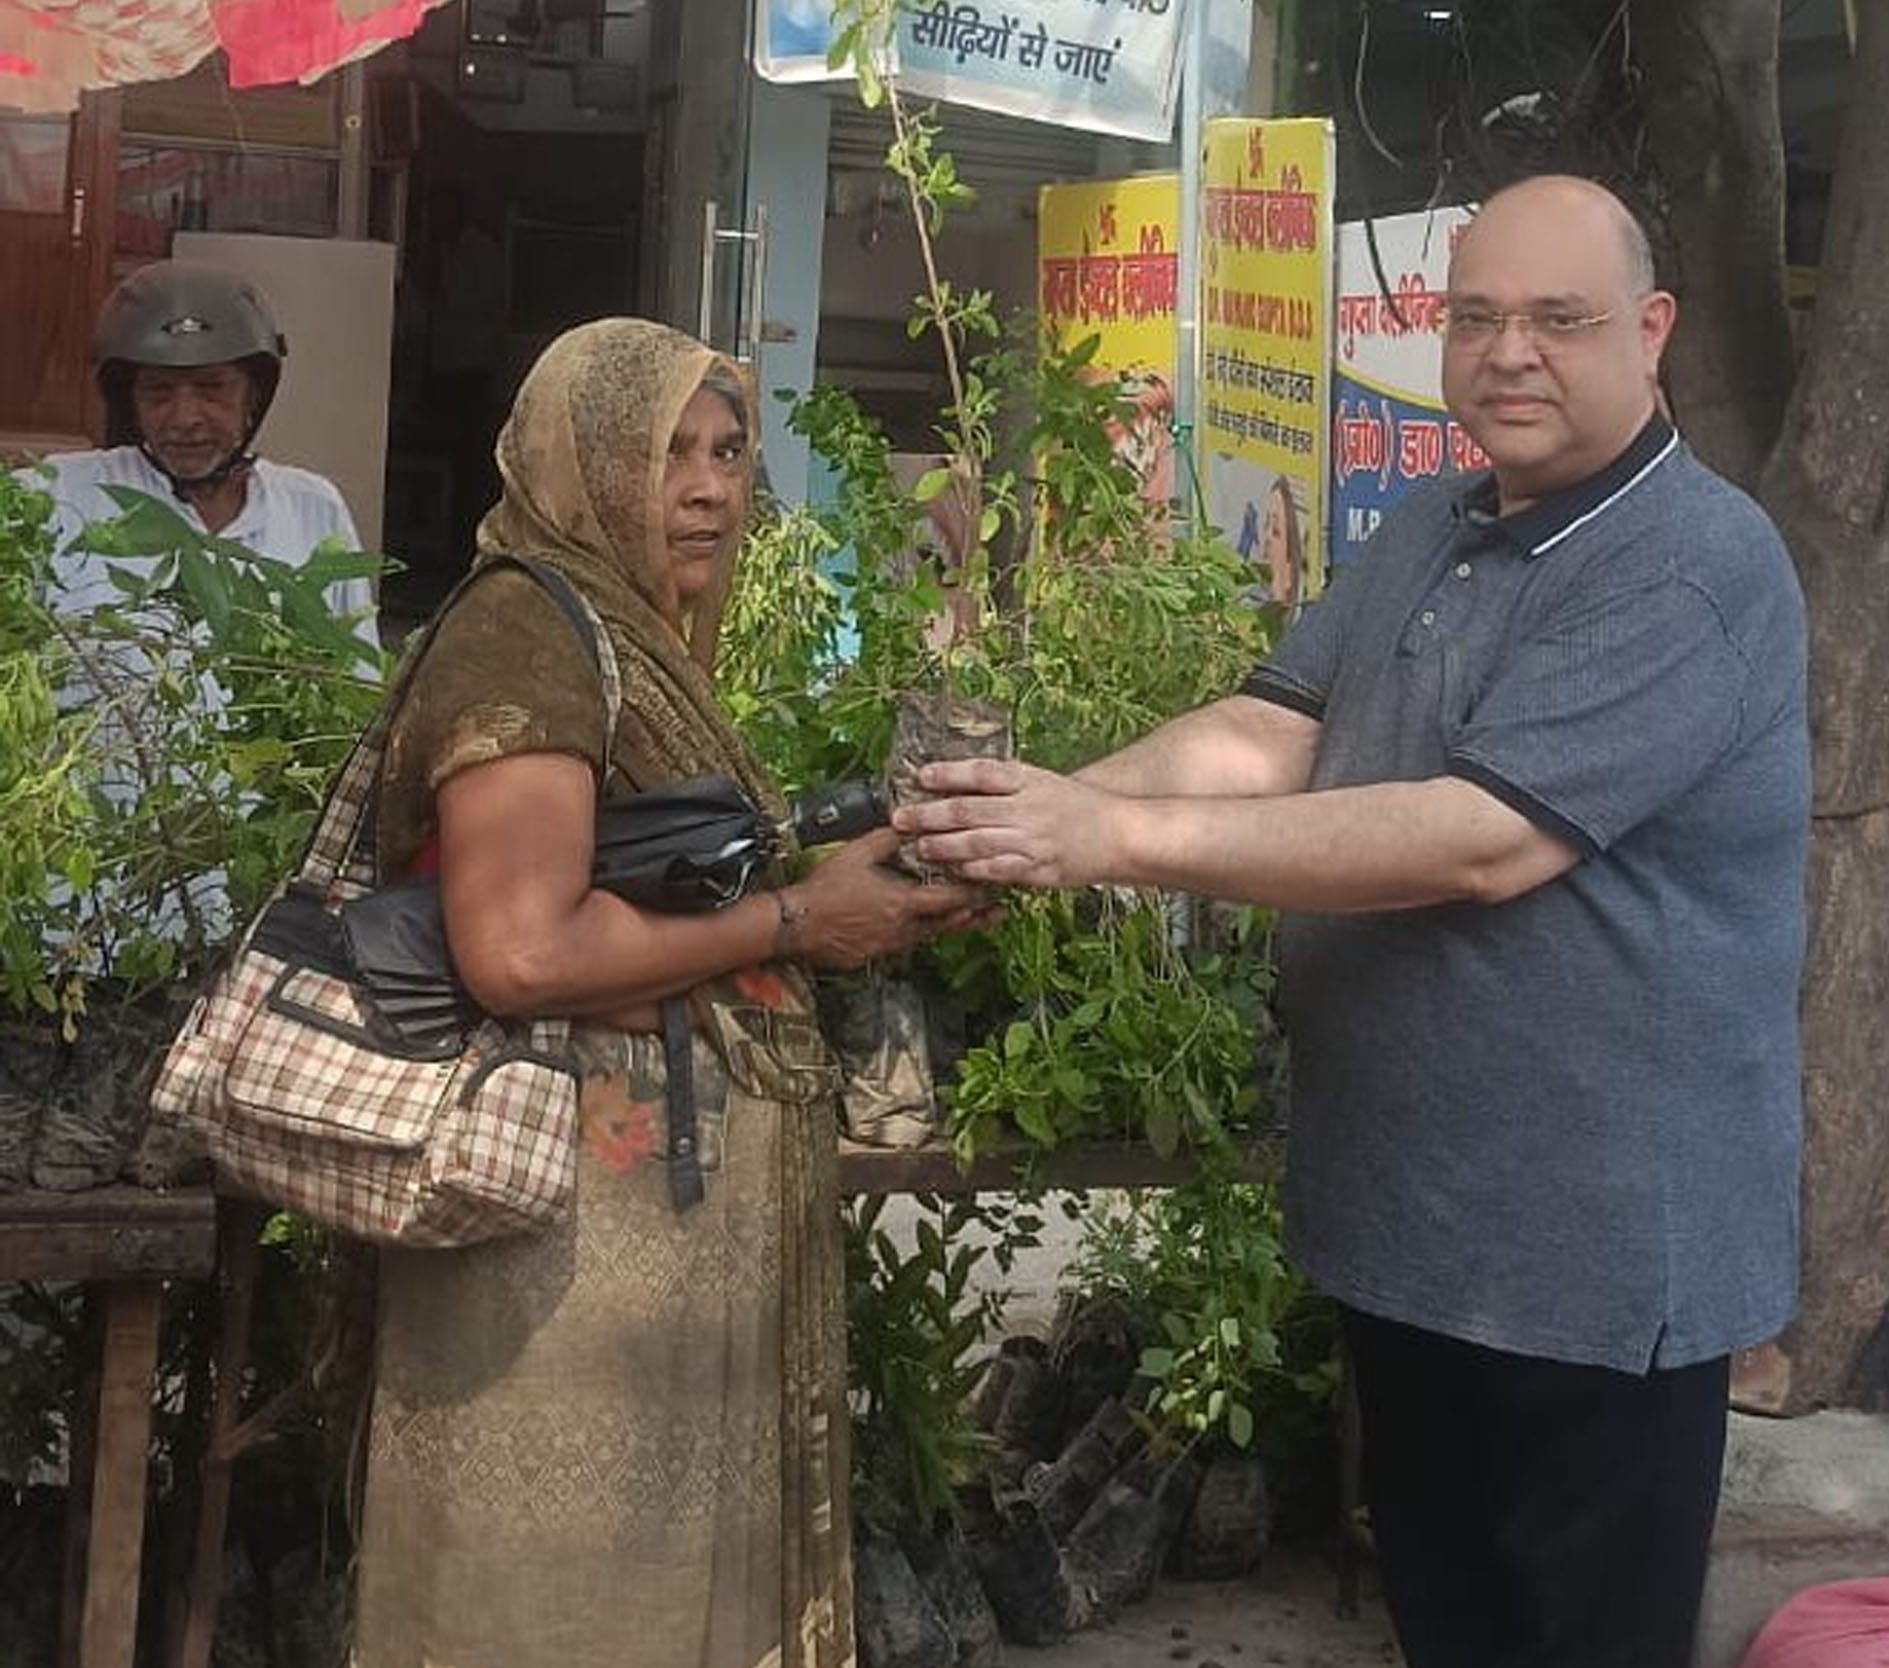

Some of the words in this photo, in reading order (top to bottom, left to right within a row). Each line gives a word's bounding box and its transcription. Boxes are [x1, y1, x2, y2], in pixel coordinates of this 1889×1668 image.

[912, 0, 1020, 64] सीढ़ियों
[1018, 21, 1049, 69] से
[1054, 37, 1123, 84] जाएं
